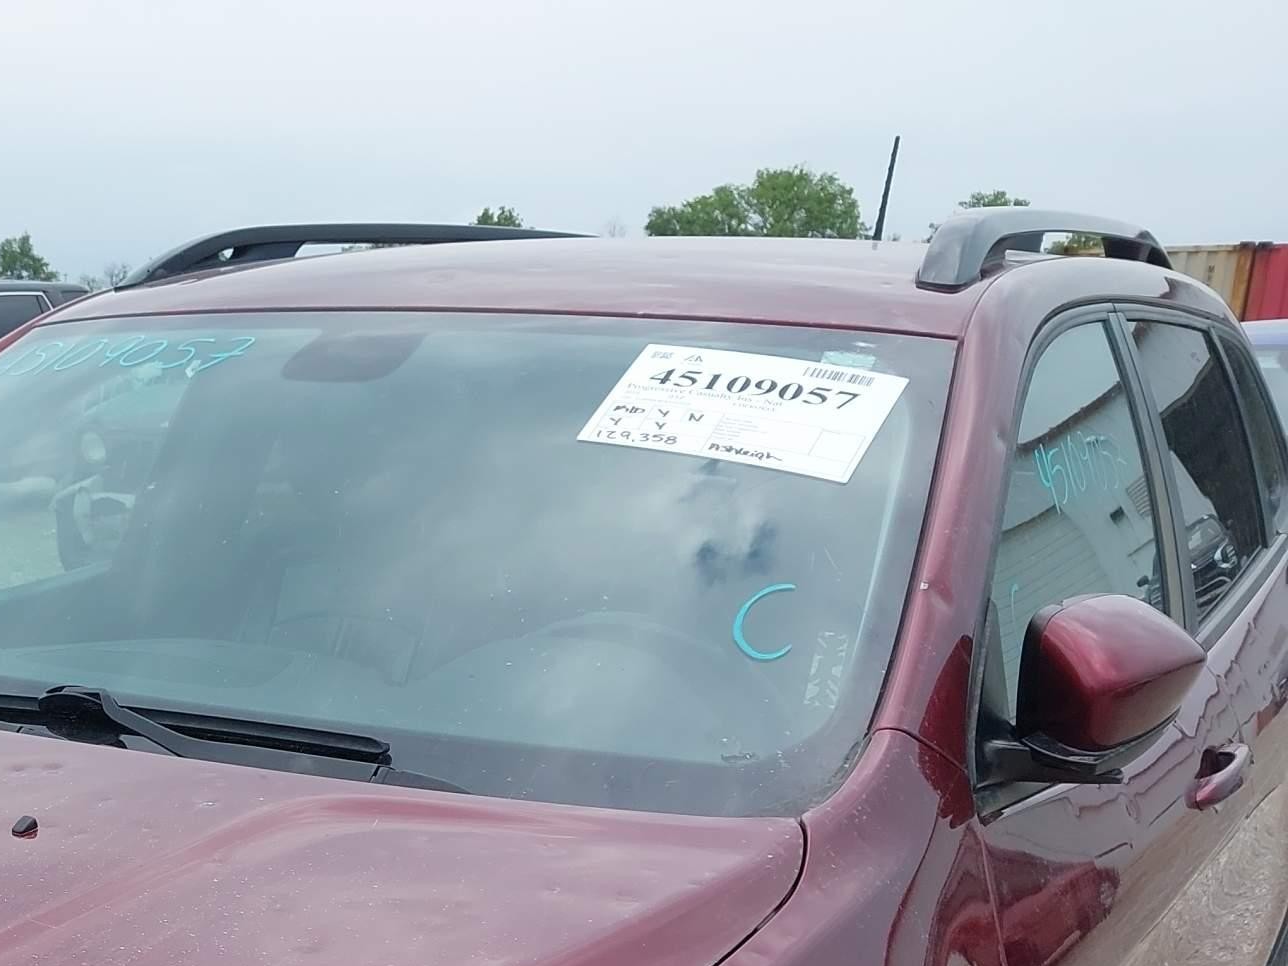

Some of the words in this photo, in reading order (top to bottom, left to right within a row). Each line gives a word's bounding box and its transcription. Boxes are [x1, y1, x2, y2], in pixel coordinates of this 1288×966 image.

[649, 367, 862, 410] 45109057
[688, 413, 705, 423] N
[733, 583, 797, 661] C
